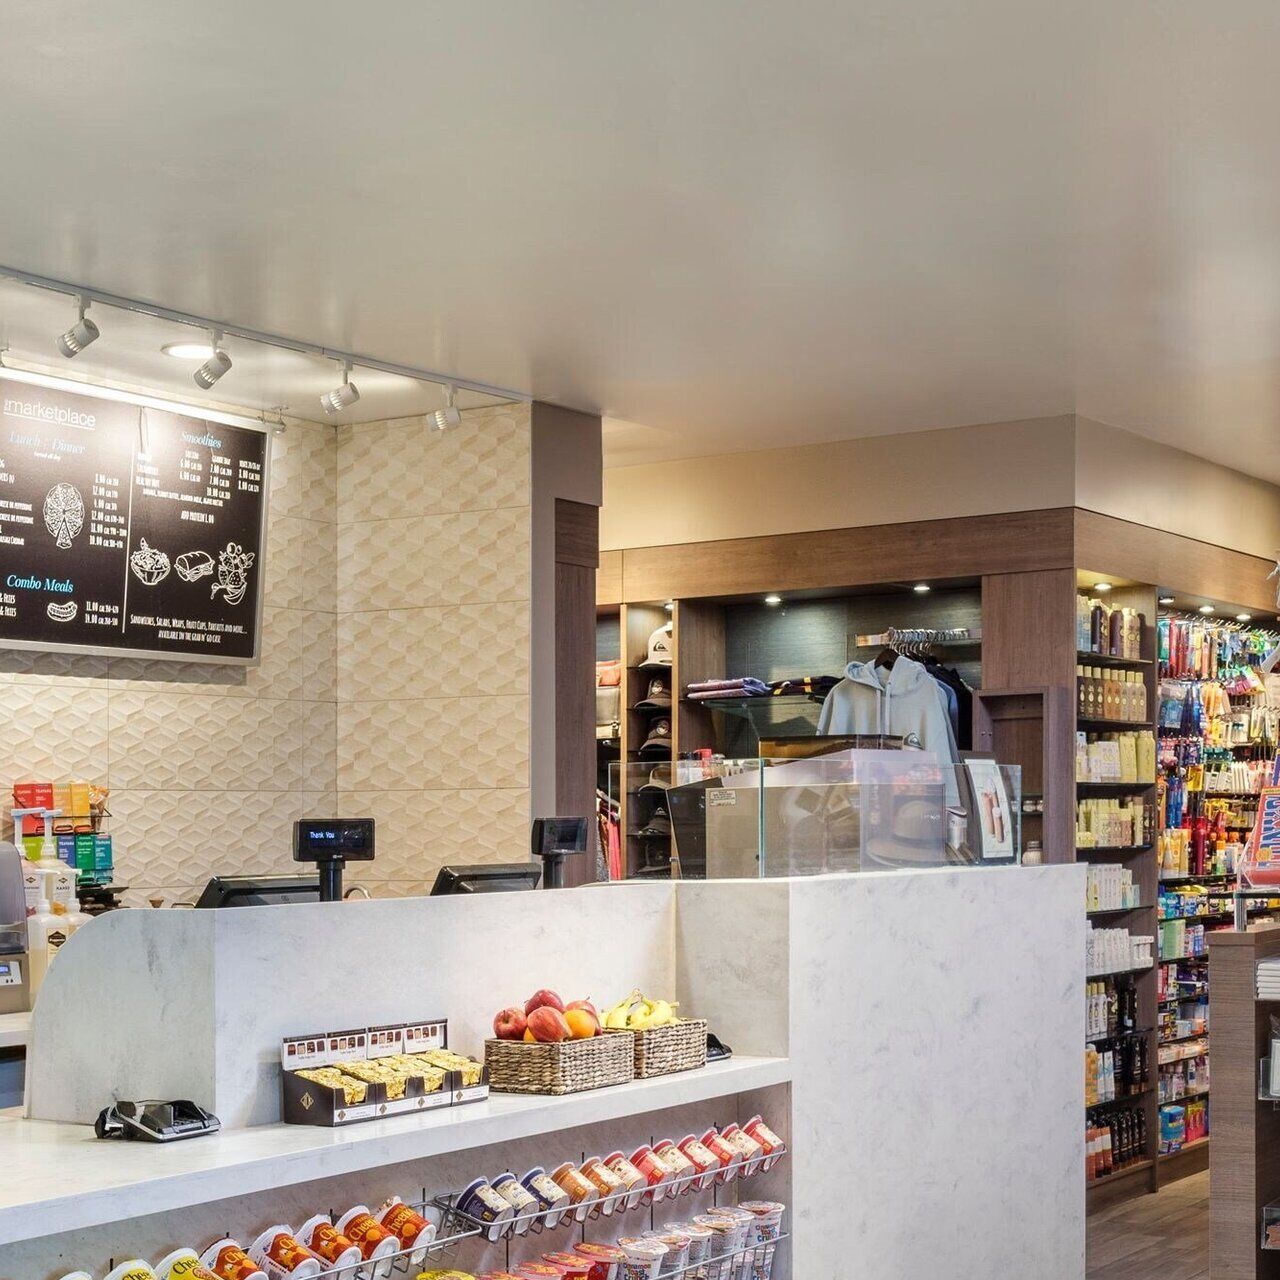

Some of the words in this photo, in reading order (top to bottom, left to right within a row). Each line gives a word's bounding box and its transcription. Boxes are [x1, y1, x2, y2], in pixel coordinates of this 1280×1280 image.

[8, 401, 95, 427] marketplace
[180, 431, 222, 449] Smoothies
[6, 574, 42, 590] Combo
[43, 578, 74, 594] Meals
[310, 831, 324, 839] Thank
[325, 831, 335, 839] You
